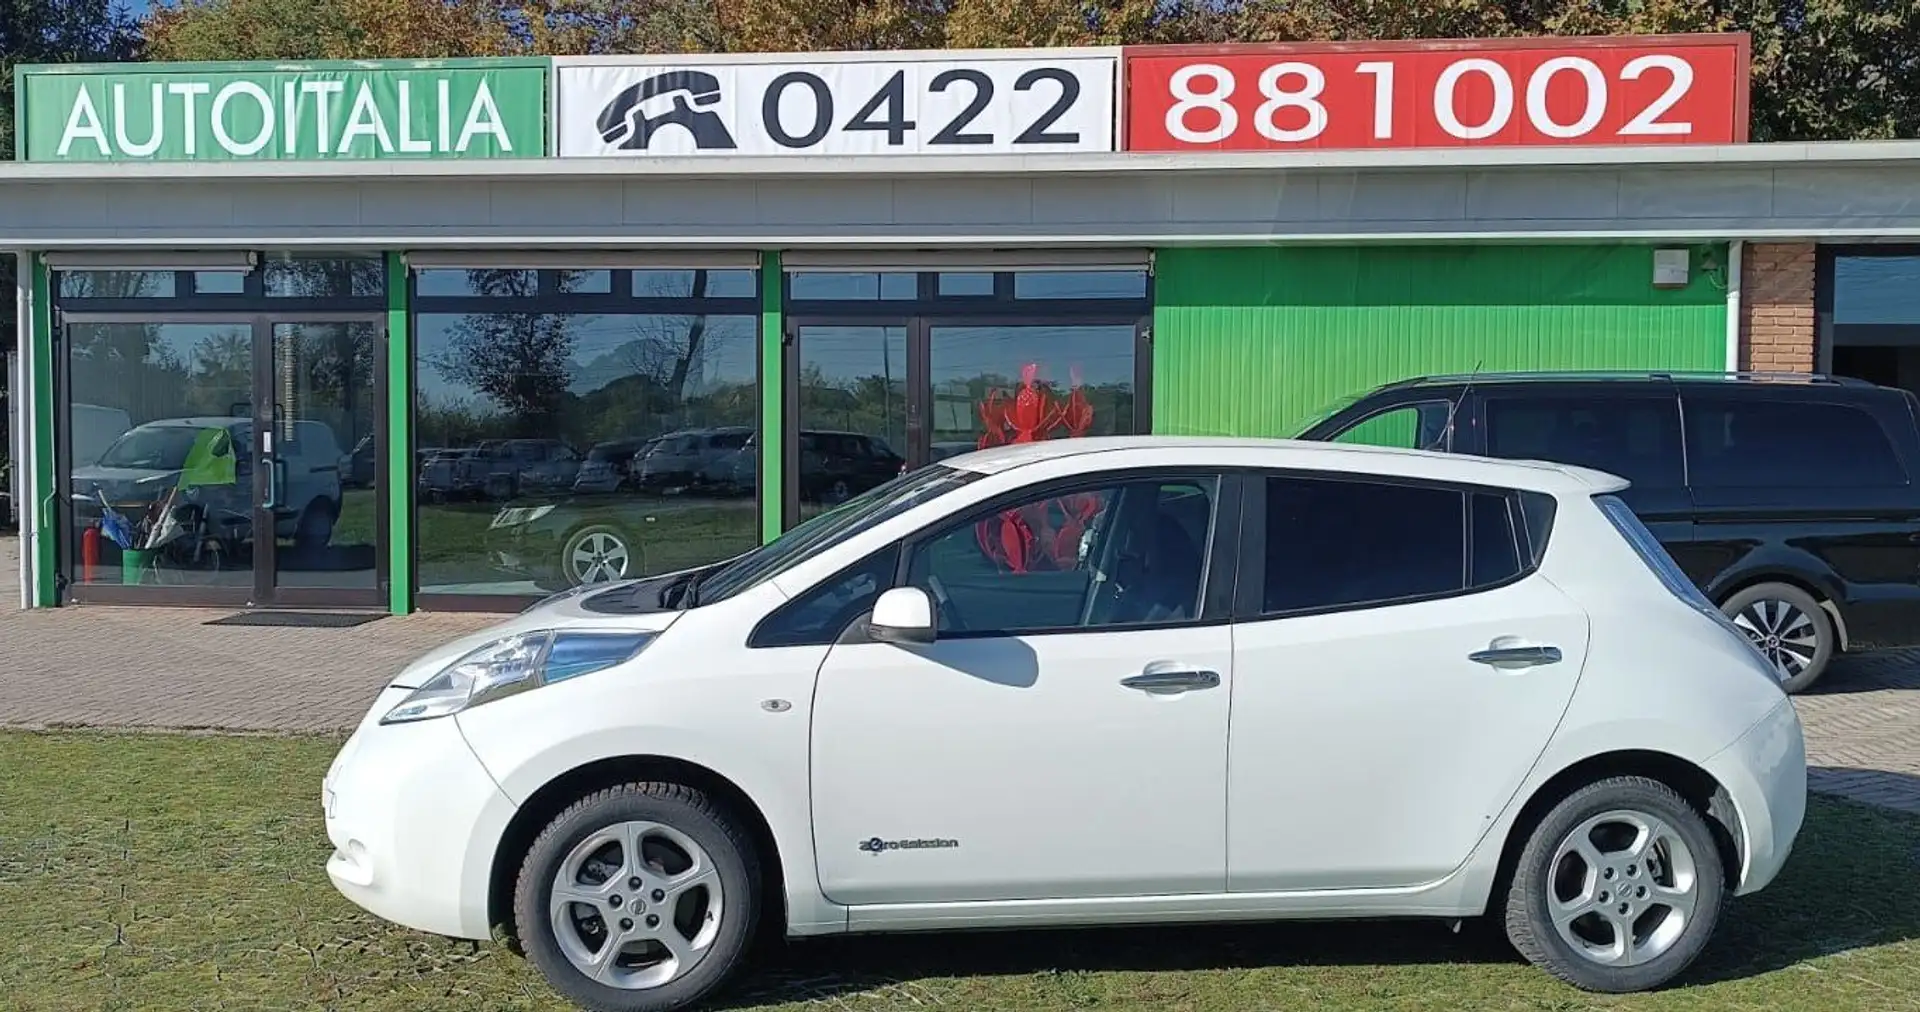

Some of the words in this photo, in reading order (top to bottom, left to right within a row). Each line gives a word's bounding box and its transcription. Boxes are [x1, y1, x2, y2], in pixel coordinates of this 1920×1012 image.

[56, 78, 513, 157] AUTOITALIA
[762, 67, 1081, 149] 0422
[1164, 54, 1694, 143] 881002
